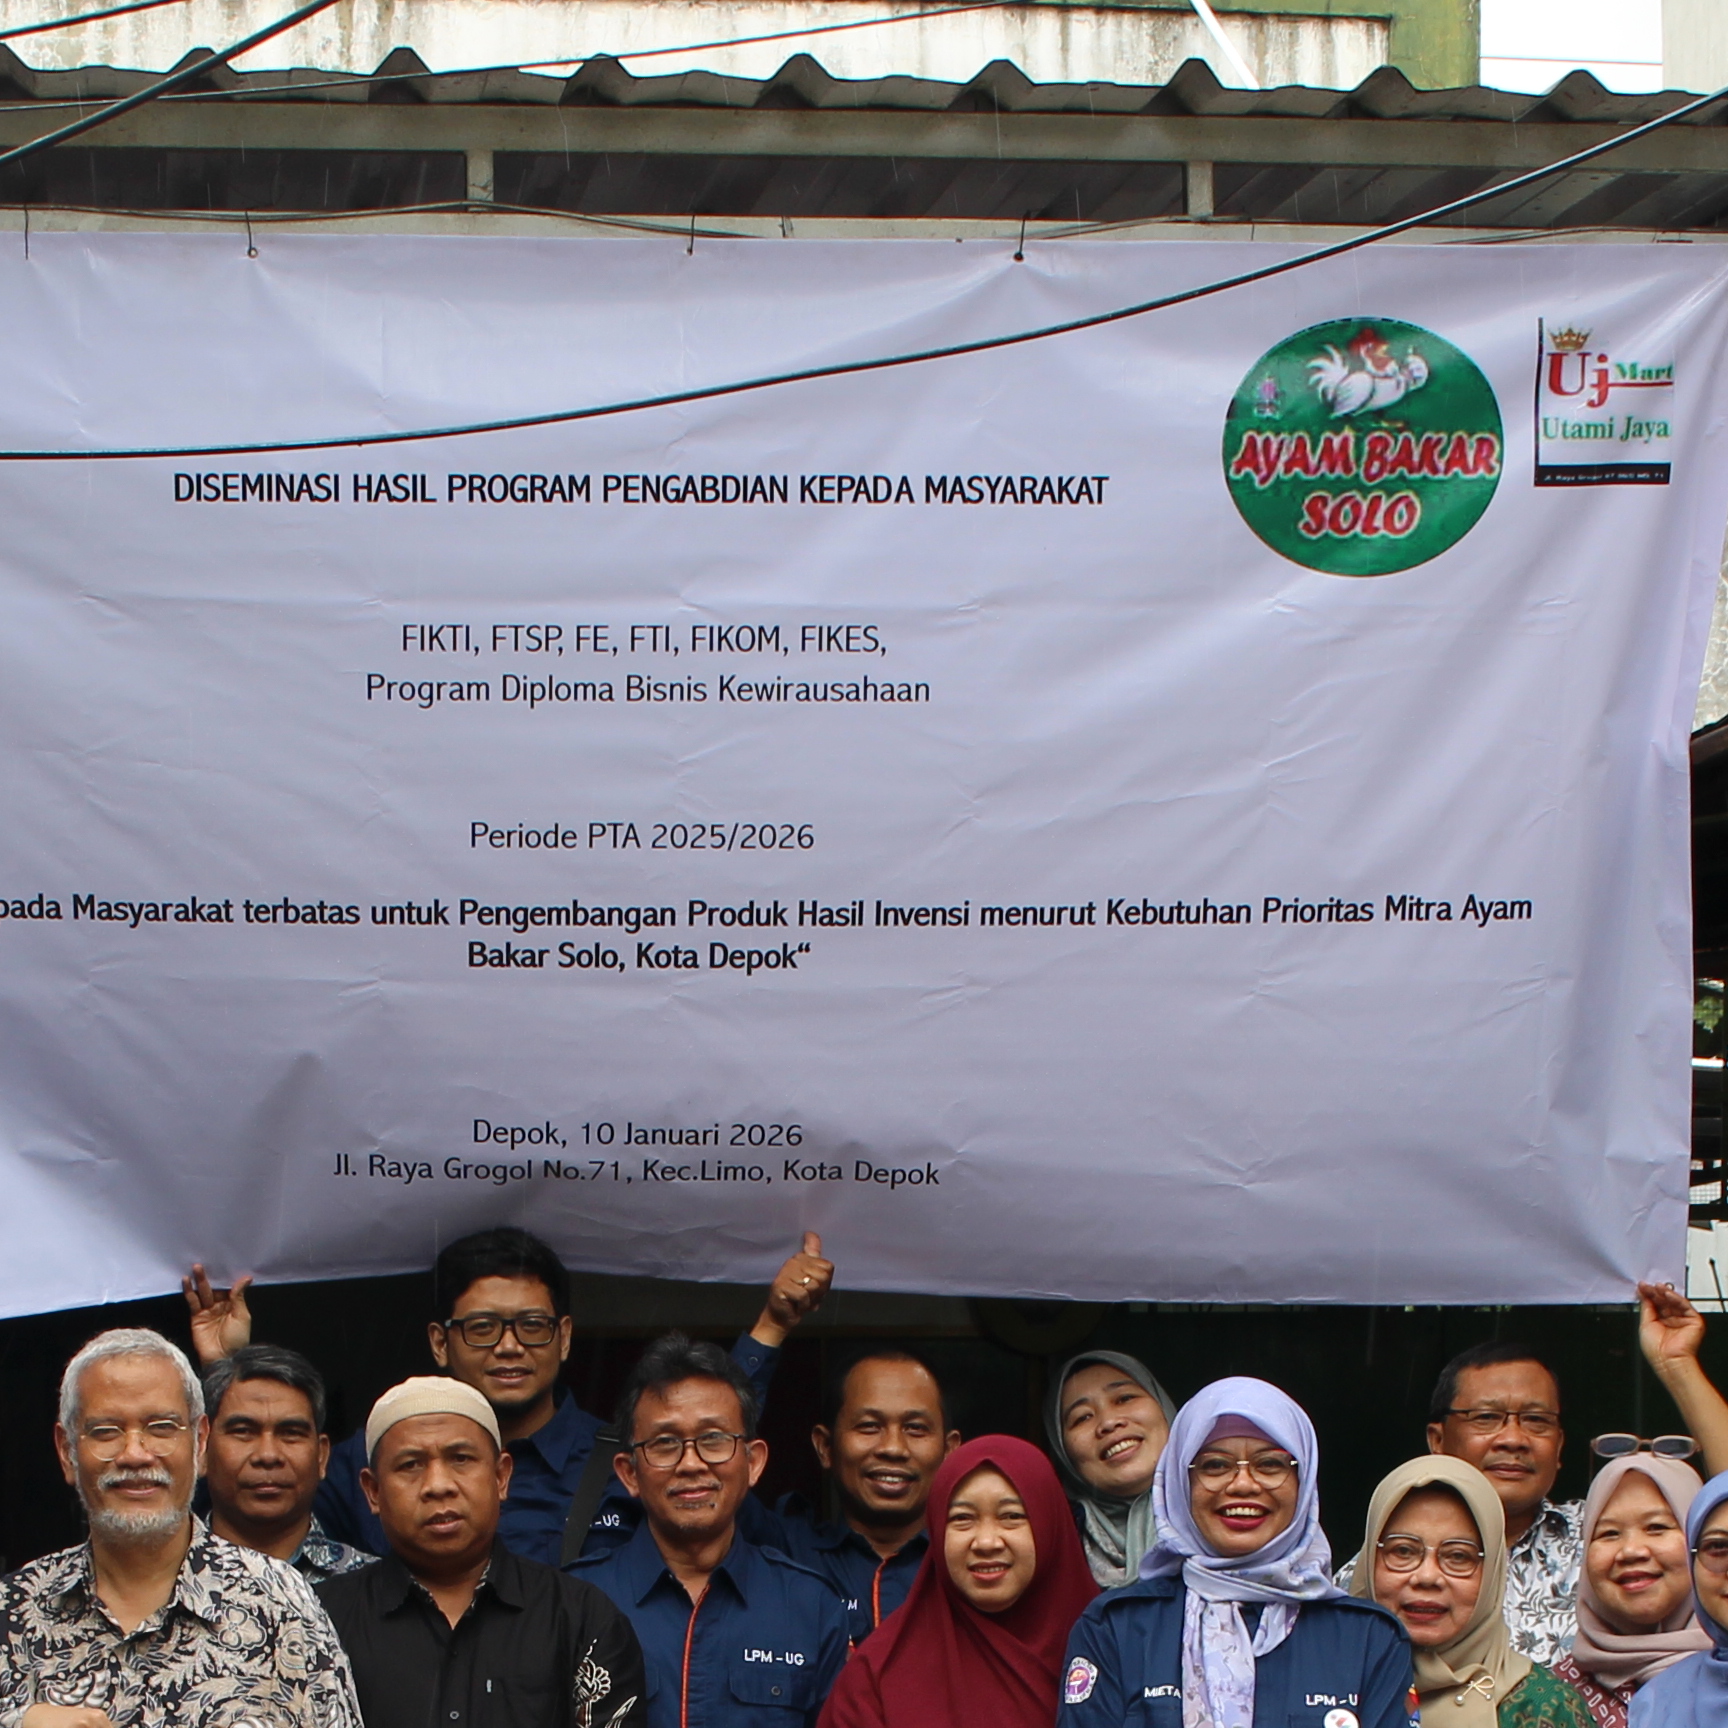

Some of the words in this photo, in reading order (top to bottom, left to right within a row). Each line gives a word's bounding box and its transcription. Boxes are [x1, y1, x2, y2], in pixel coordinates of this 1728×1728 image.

[1614, 360, 1674, 381] Mart
[1541, 416, 1614, 440] Utami
[1620, 415, 1670, 443] Jaya
[1229, 430, 1357, 488] AYAM
[1361, 431, 1501, 485] BAKAR
[173, 472, 340, 503] DISEMINASI
[352, 472, 438, 504] HASIL
[447, 473, 591, 504] PROGRAM
[602, 473, 789, 504] PENGABDIAN
[799, 474, 916, 505] KEPADA
[924, 474, 1110, 505] MASYARAKAT
[1298, 490, 1422, 539] SOLO
[402, 623, 480, 657] FIKTI,
[492, 624, 564, 658] FTSP,
[575, 624, 618, 658] FE,
[630, 624, 680, 658] FTI,
[691, 624, 789, 657] FIKOM,
[800, 624, 887, 658] FIKES,
[366, 672, 490, 710] Program
[502, 673, 616, 710] Diploma
[625, 673, 708, 703] Bisnis
[718, 673, 930, 703] Kewirausahaan
[470, 821, 578, 850] Periode
[588, 822, 642, 850] PTA
[651, 822, 815, 853] 2025/2026
[72, 893, 235, 930] Masyarakat
[241, 896, 361, 925] terbatas
[370, 898, 451, 926] untuk
[459, 898, 677, 935] Pengembangan
[687, 899, 790, 928] Produk
[797, 899, 865, 928] Hasil
[874, 899, 971, 927] Invensi
[979, 901, 1098, 927] menurut
[1106, 896, 1252, 926] Kebutuhan
[1262, 896, 1375, 924] Prioritas
[1384, 893, 1454, 922] Mitra
[1459, 893, 1533, 929] Ayam
[468, 940, 551, 969] Bakar
[557, 941, 626, 974] Solo,
[636, 941, 701, 970] Kota
[473, 1118, 568, 1151] Depok,
[581, 1122, 615, 1146] 10
[623, 1121, 720, 1147] Januari
[729, 1123, 803, 1147] 2026
[368, 1153, 435, 1185] Raya
[443, 1156, 533, 1186] Grogol
[543, 1159, 630, 1183] No.71,
[642, 1159, 772, 1185] Kec.Limo,
[783, 1158, 844, 1181] Kota
[854, 1159, 940, 1191] Depok
[602, 1513, 620, 1527] UG
[744, 1648, 773, 1663] LPM
[785, 1651, 805, 1666] UG
[1306, 1692, 1337, 1707] LPM
